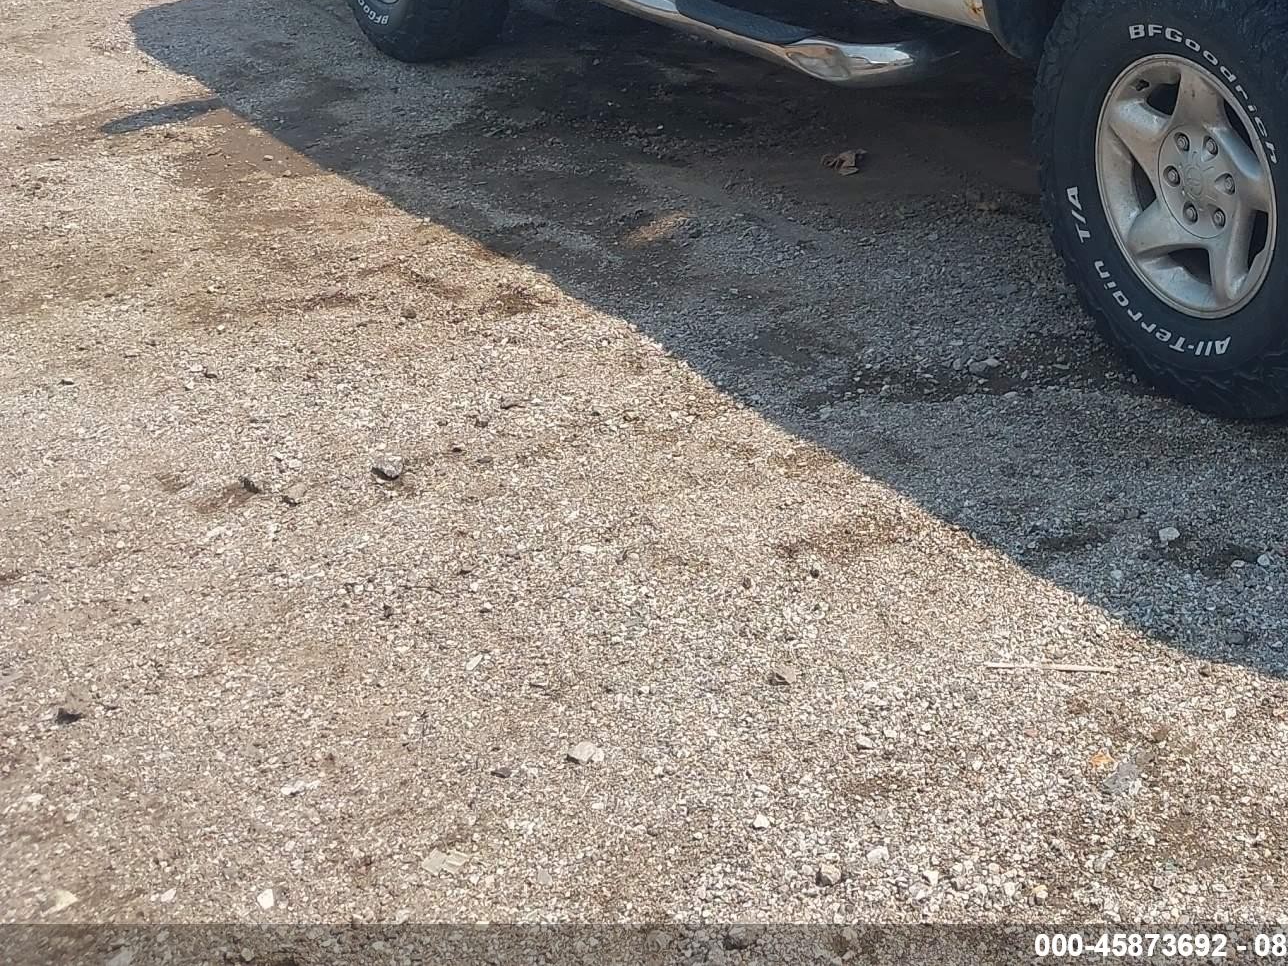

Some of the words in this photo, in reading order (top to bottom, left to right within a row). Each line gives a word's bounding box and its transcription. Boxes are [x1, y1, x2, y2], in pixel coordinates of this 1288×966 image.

[1128, 23, 1278, 165] BFGoodrich
[1066, 185, 1091, 244] T/A
[1093, 260, 1233, 357] All-Terrain
